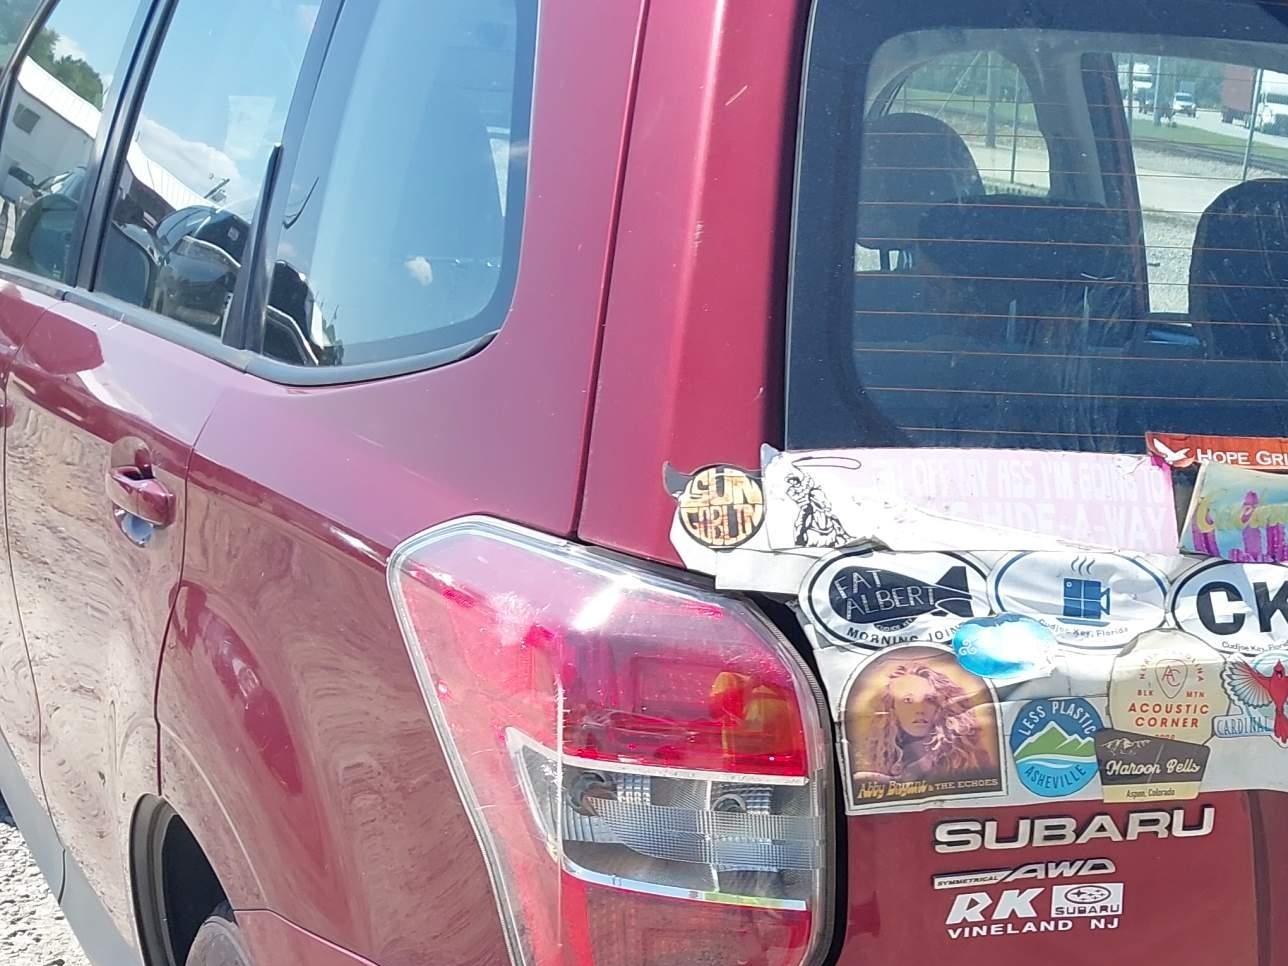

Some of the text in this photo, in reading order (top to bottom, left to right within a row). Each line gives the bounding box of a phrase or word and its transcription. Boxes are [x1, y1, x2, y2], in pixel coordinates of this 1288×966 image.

[834, 570, 881, 599] FAT
[846, 586, 938, 620] ALBERT
[1018, 700, 1096, 736] LESS PLASTIC
[1128, 703, 1210, 715] ACOUSTIC
[1135, 717, 1199, 728] CORNER
[1217, 716, 1271, 736] CARDINAL
[1025, 764, 1087, 789] ASHEVILLE
[1166, 758, 1201, 775] Bells
[935, 782, 956, 791] THE
[957, 778, 999, 789] ECHOES
[934, 807, 1216, 853] SUBARU
[937, 858, 1117, 887] SYMMETRICAL AWD
[945, 887, 1045, 925] RK
[1054, 904, 1121, 916] SUBARU
[948, 918, 1120, 940] VINELAND NJ
